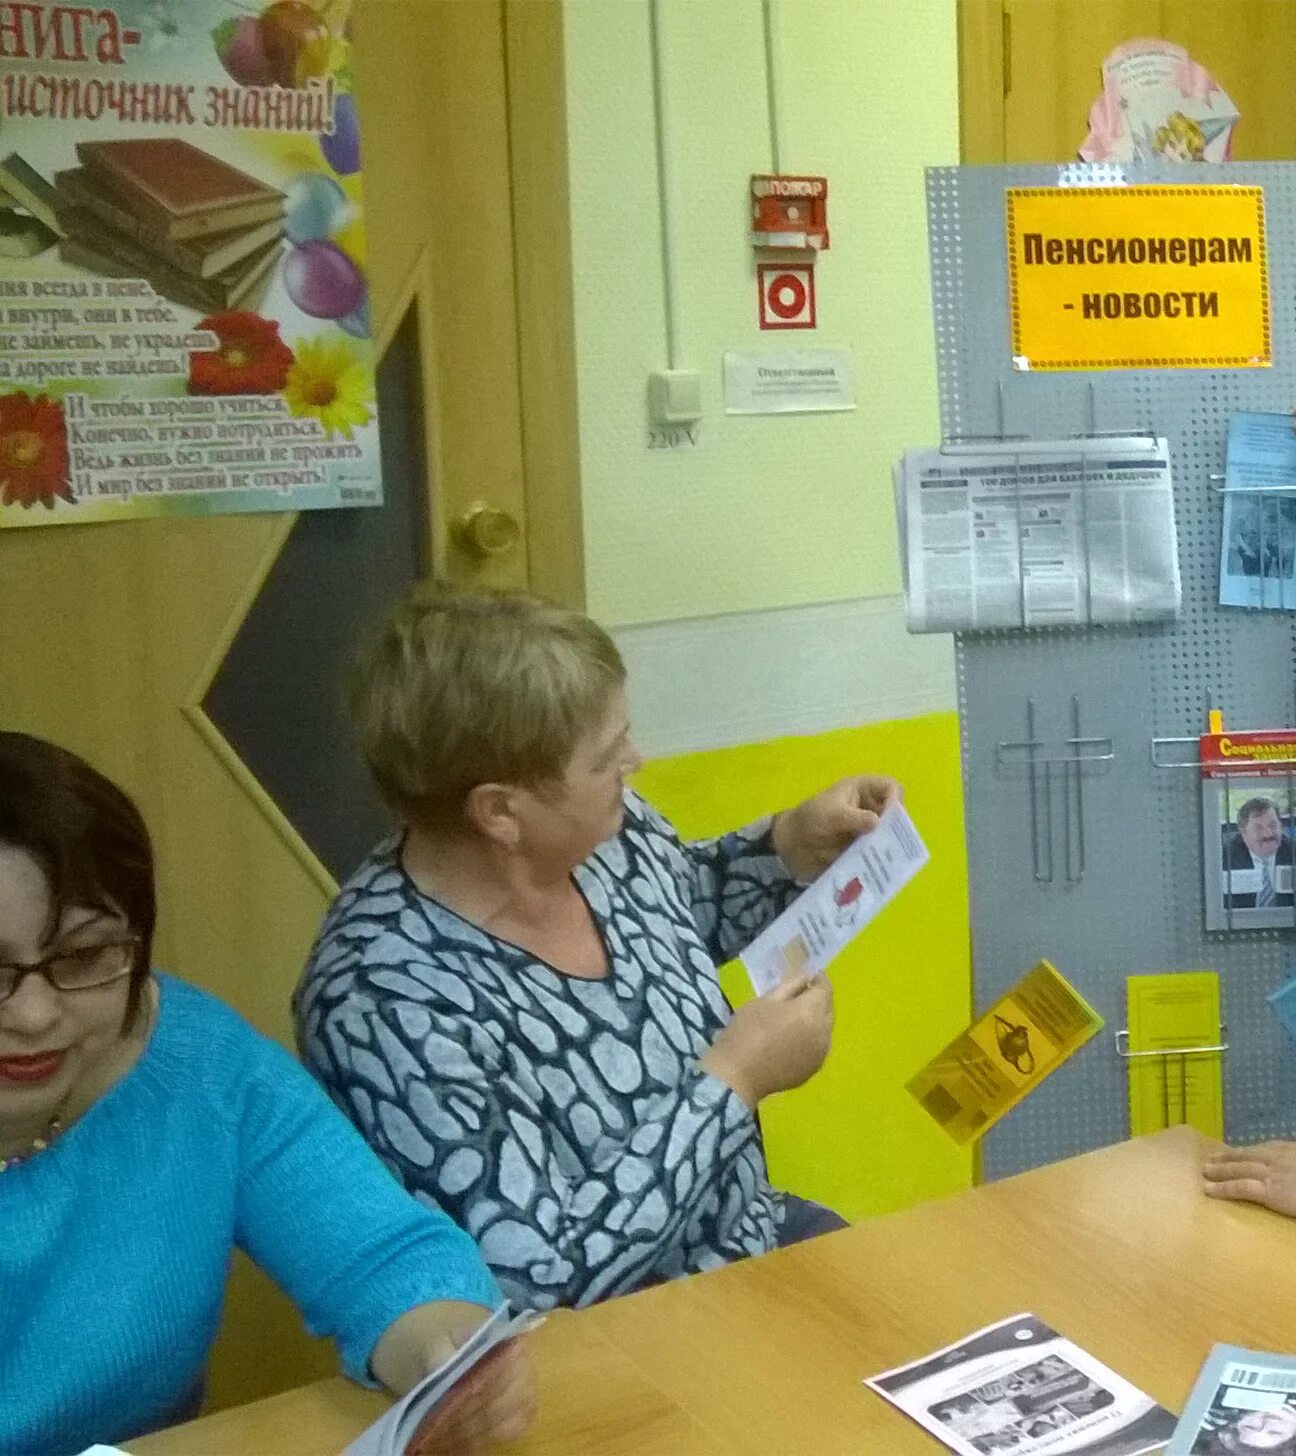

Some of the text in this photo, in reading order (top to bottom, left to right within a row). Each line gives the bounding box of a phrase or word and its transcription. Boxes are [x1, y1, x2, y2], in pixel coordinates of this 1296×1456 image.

[0, 3, 142, 64] нига-
[3, 73, 335, 134] источник знаний!
[1023, 232, 1253, 267] Пенсионерам
[110, 334, 130, 349] не
[15, 360, 76, 385] дороге
[81, 360, 101, 376] не
[68, 395, 84, 419] И
[91, 395, 143, 417] чтобы
[150, 400, 215, 423] хорошо
[157, 427, 213, 446] нужно
[74, 449, 114, 471] Ведь
[119, 453, 172, 468] жизнь
[177, 444, 202, 465] без
[270, 447, 287, 461] не
[76, 473, 92, 496] И
[97, 479, 132, 501] мир
[135, 472, 163, 492] без
[231, 472, 249, 488] не
